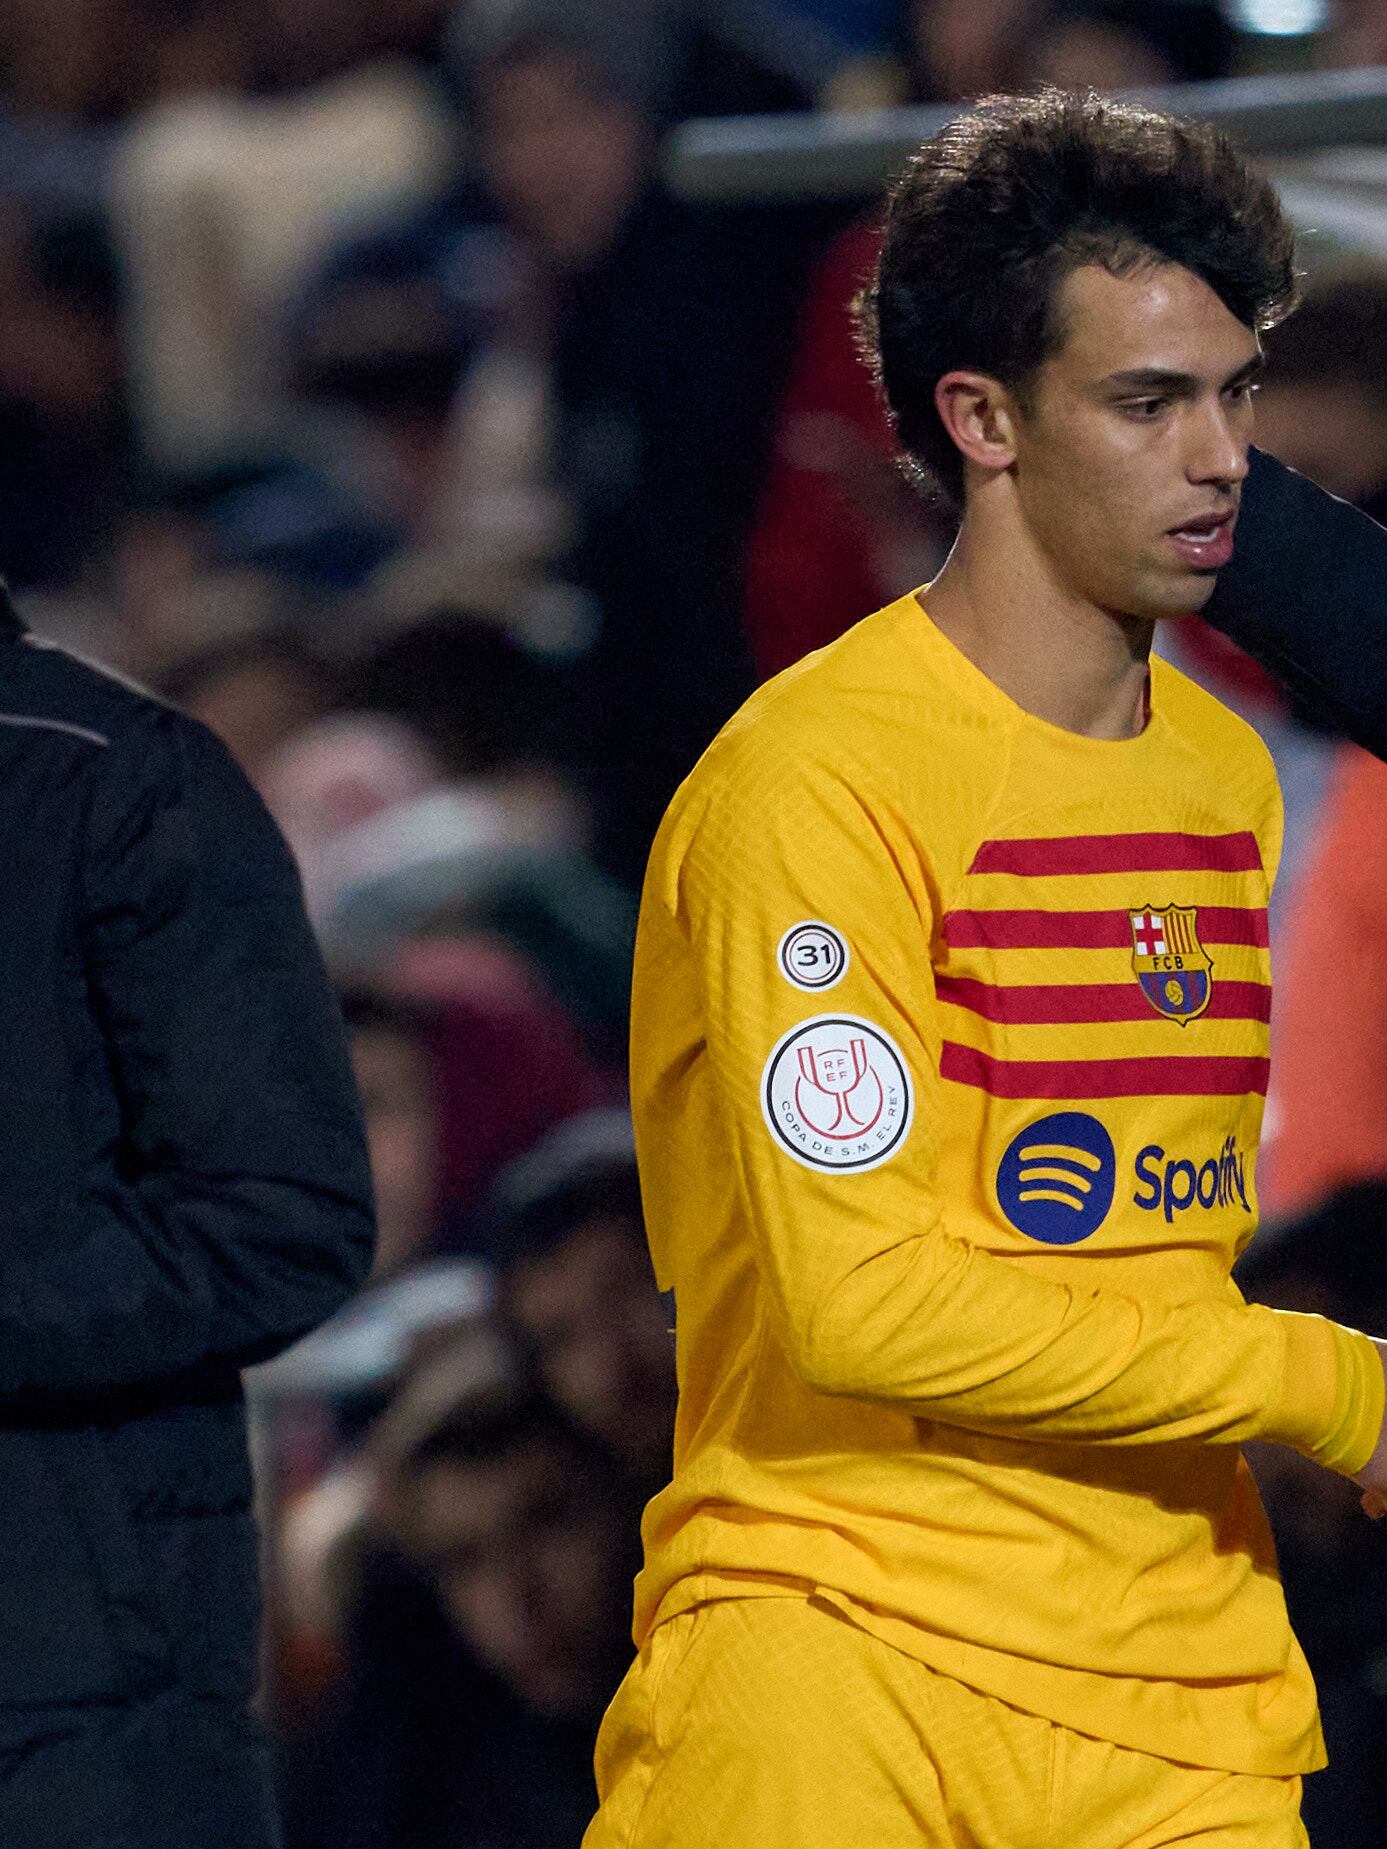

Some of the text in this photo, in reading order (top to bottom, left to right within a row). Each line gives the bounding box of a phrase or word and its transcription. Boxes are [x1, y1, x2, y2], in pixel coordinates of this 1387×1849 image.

[797, 944, 831, 967] 31
[1153, 956, 1184, 972] FCB
[782, 1100, 807, 1142] COPA
[812, 1141, 833, 1155] DE
[876, 1124, 892, 1140] EL
[888, 1086, 898, 1117] REY
[1133, 1136, 1252, 1223] Spotify
